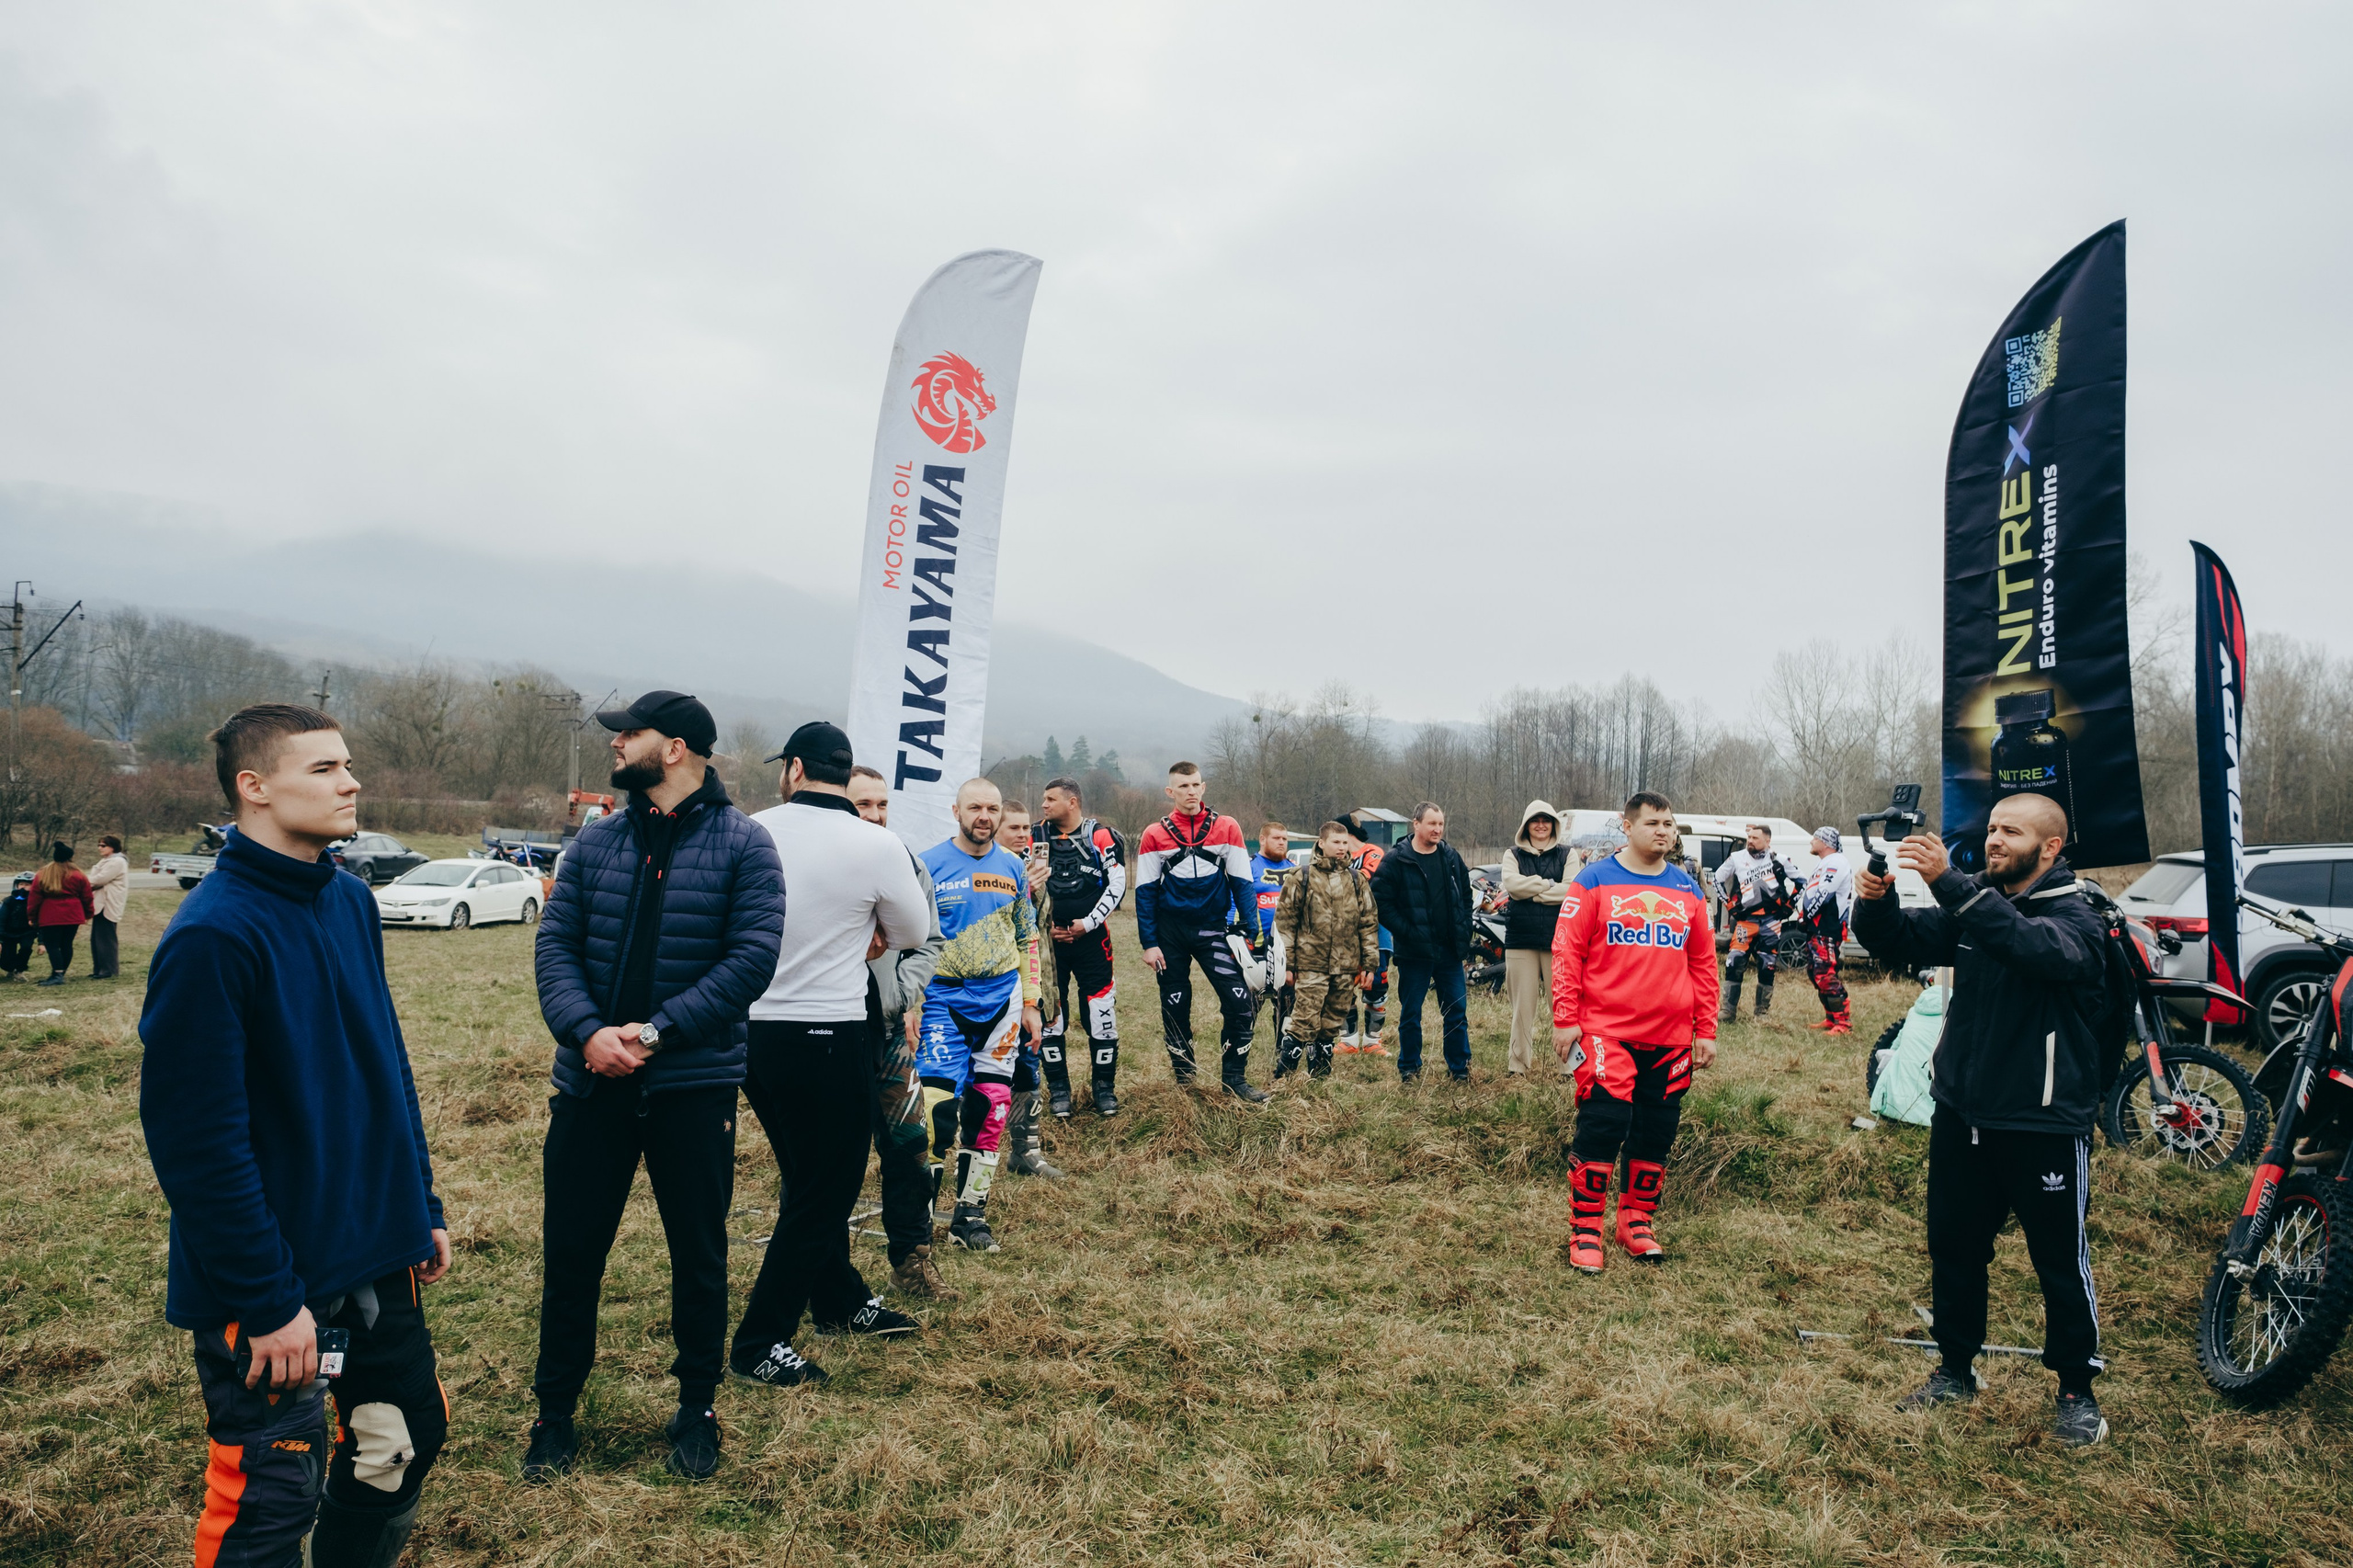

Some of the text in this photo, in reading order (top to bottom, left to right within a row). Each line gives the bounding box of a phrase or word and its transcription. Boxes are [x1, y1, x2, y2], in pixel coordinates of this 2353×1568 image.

[882, 460, 913, 590] MOTOR OIL
[1997, 413, 2034, 676] NITREX
[2038, 462, 2058, 669] Enduro vitamins
[893, 463, 966, 791] TAKAYAMA
[1998, 765, 2056, 781] NITREX
[2031, 778, 2058, 788] ПАДЕНИЙ
[935, 878, 1017, 892] Hard enduro
[1608, 922, 1652, 945] Red
[1592, 1035, 1607, 1082] ASGAS
[2250, 1178, 2278, 1238] KENDA
[270, 1439, 312, 1452] KTM
